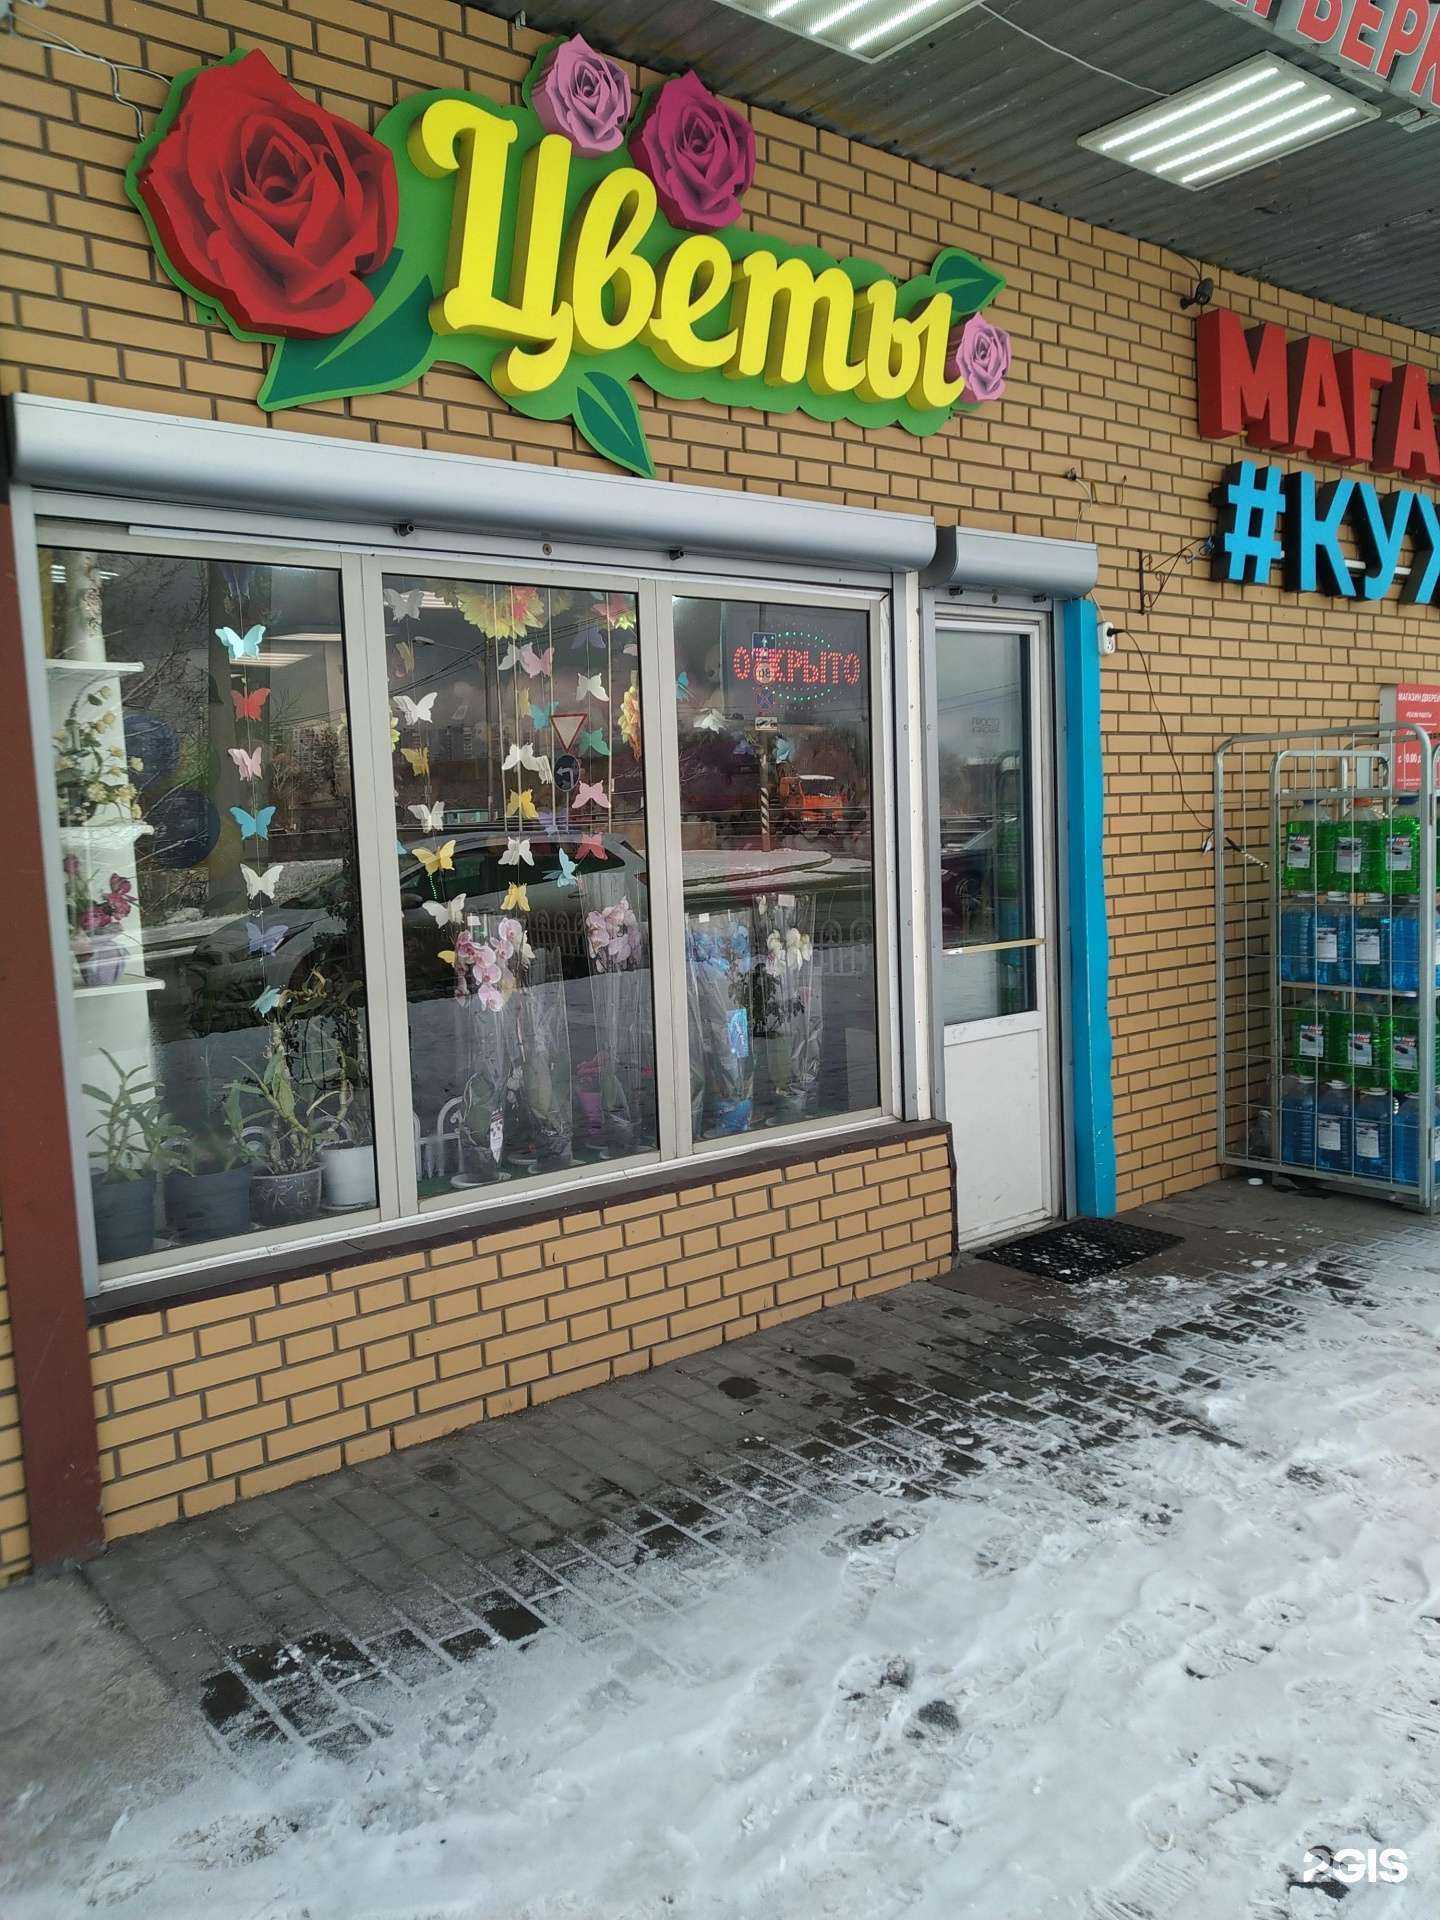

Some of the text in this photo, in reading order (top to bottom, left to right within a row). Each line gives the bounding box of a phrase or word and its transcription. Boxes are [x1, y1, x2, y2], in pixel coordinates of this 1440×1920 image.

[408, 98, 966, 410] Цветы
[1197, 308, 1440, 480] МАГА
[732, 645, 862, 686] ОТКРЫТО
